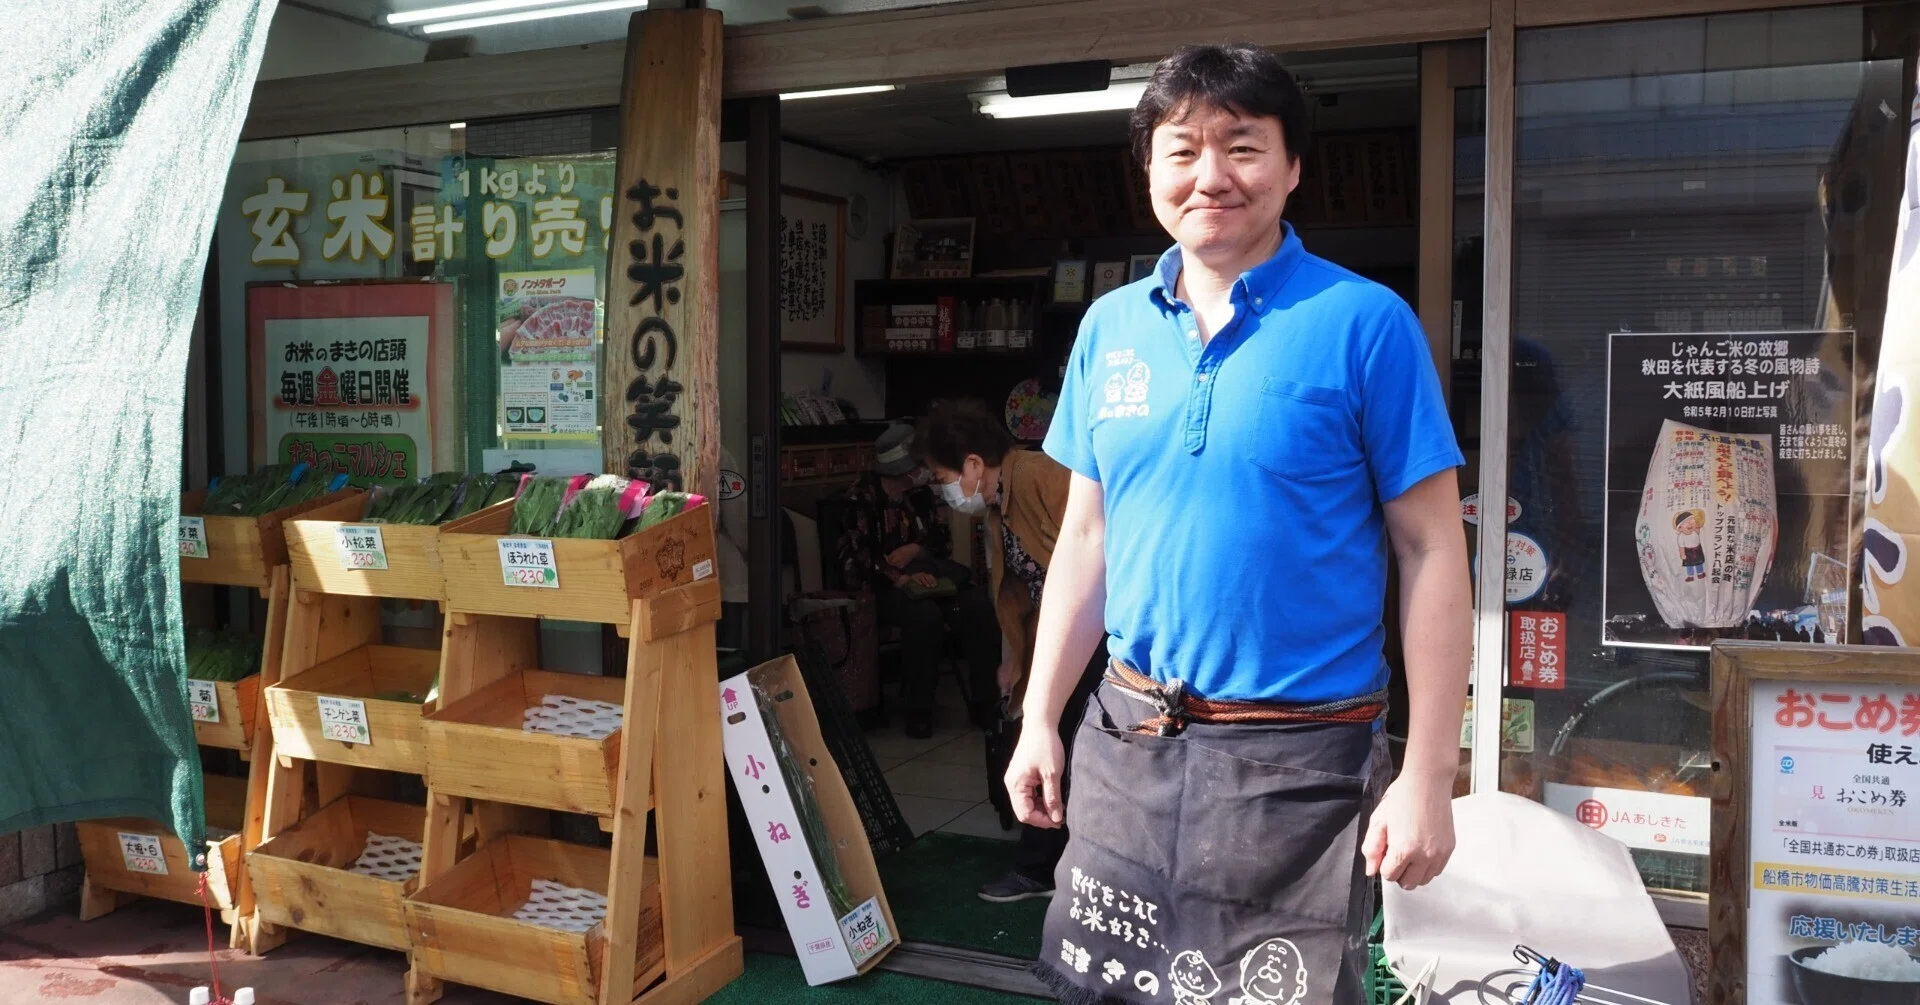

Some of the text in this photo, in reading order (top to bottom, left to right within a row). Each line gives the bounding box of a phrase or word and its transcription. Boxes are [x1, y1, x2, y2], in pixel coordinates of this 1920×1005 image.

[458, 163, 575, 199] 1kgより
[242, 170, 395, 265] 玄米
[410, 193, 613, 261] 計り売
[285, 338, 407, 363] お米のまきの店頭
[1671, 340, 1789, 357] じゃんご米の故郷
[1641, 357, 1821, 376] 秋田を代表する冬の風物詩
[280, 365, 410, 406] 毎週金曜日開催
[1662, 380, 1791, 400] 大紙風船上げ
[1683, 405, 1778, 418] 令和5年2月10日打上写真
[1779, 436, 1847, 447] 天まで届くように真冬の
[288, 440, 408, 478] すみっこマルシェ
[1779, 448, 1847, 460] 夜空に打ち上げました。
[342, 535, 377, 549] 小松菜
[507, 551, 549, 565] ほうれん草
[512, 569, 545, 584] ¥230
[1519, 616, 1536, 660] 取扱店
[1539, 616, 1559, 683] おこめ券
[324, 707, 360, 723] チンゲン菜
[727, 700, 739, 711] UP
[1866, 743, 1920, 766] 使え
[1853, 774, 1891, 786] 全国共通
[1812, 785, 1825, 800] 見
[1836, 788, 1907, 807] おこめ券
[744, 754, 811, 909] 小ねぎ
[1611, 811, 1688, 829] JAあしきた
[1783, 837, 1920, 863] 「全国共通おこめ券」取扱店
[1763, 868, 1920, 898] 船橋市物価高騰対策生活
[1070, 866, 1158, 925] 世代をこえて
[849, 911, 875, 940] 小ねぎ
[1789, 915, 1920, 946] 応援いたしま
[1074, 946, 1159, 996] まきの
